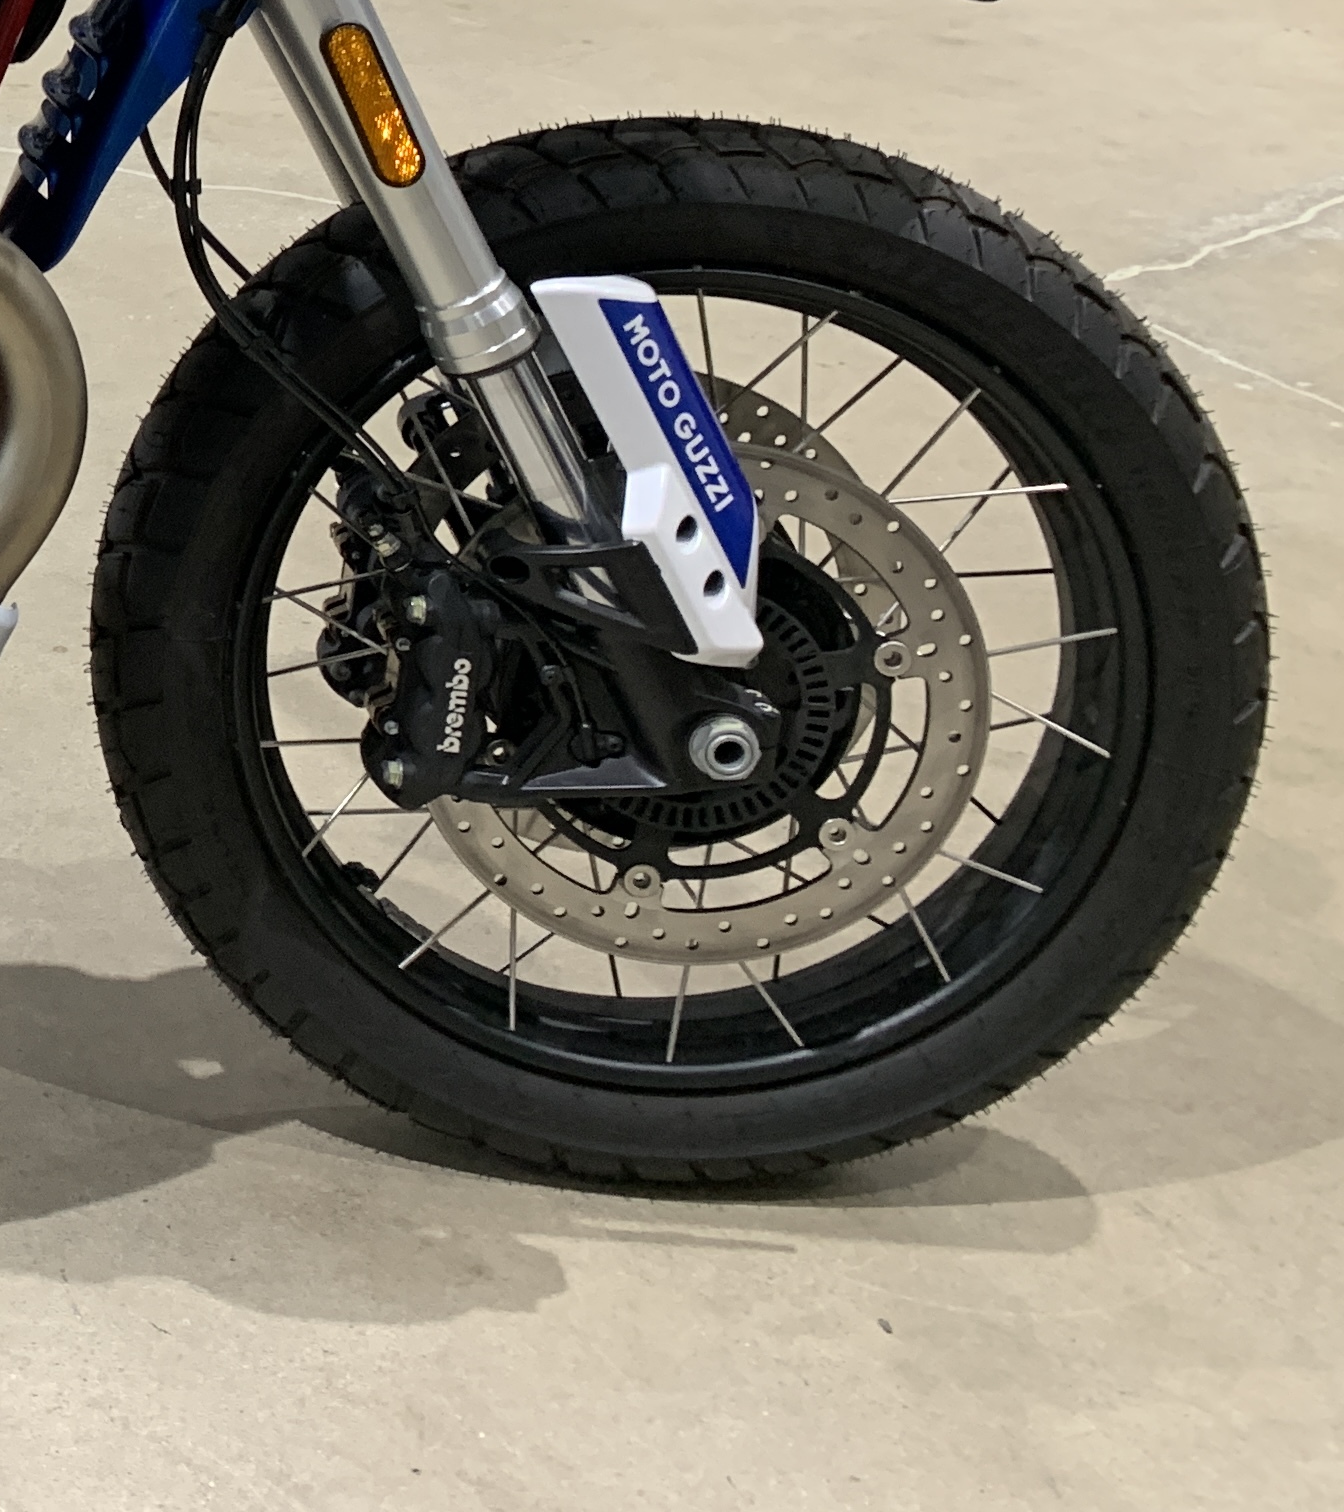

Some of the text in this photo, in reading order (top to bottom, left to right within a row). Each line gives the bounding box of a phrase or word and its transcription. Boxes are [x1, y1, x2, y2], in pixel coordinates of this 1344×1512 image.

[622, 313, 734, 512] MOTO GUZZI
[436, 658, 472, 754] brembo
